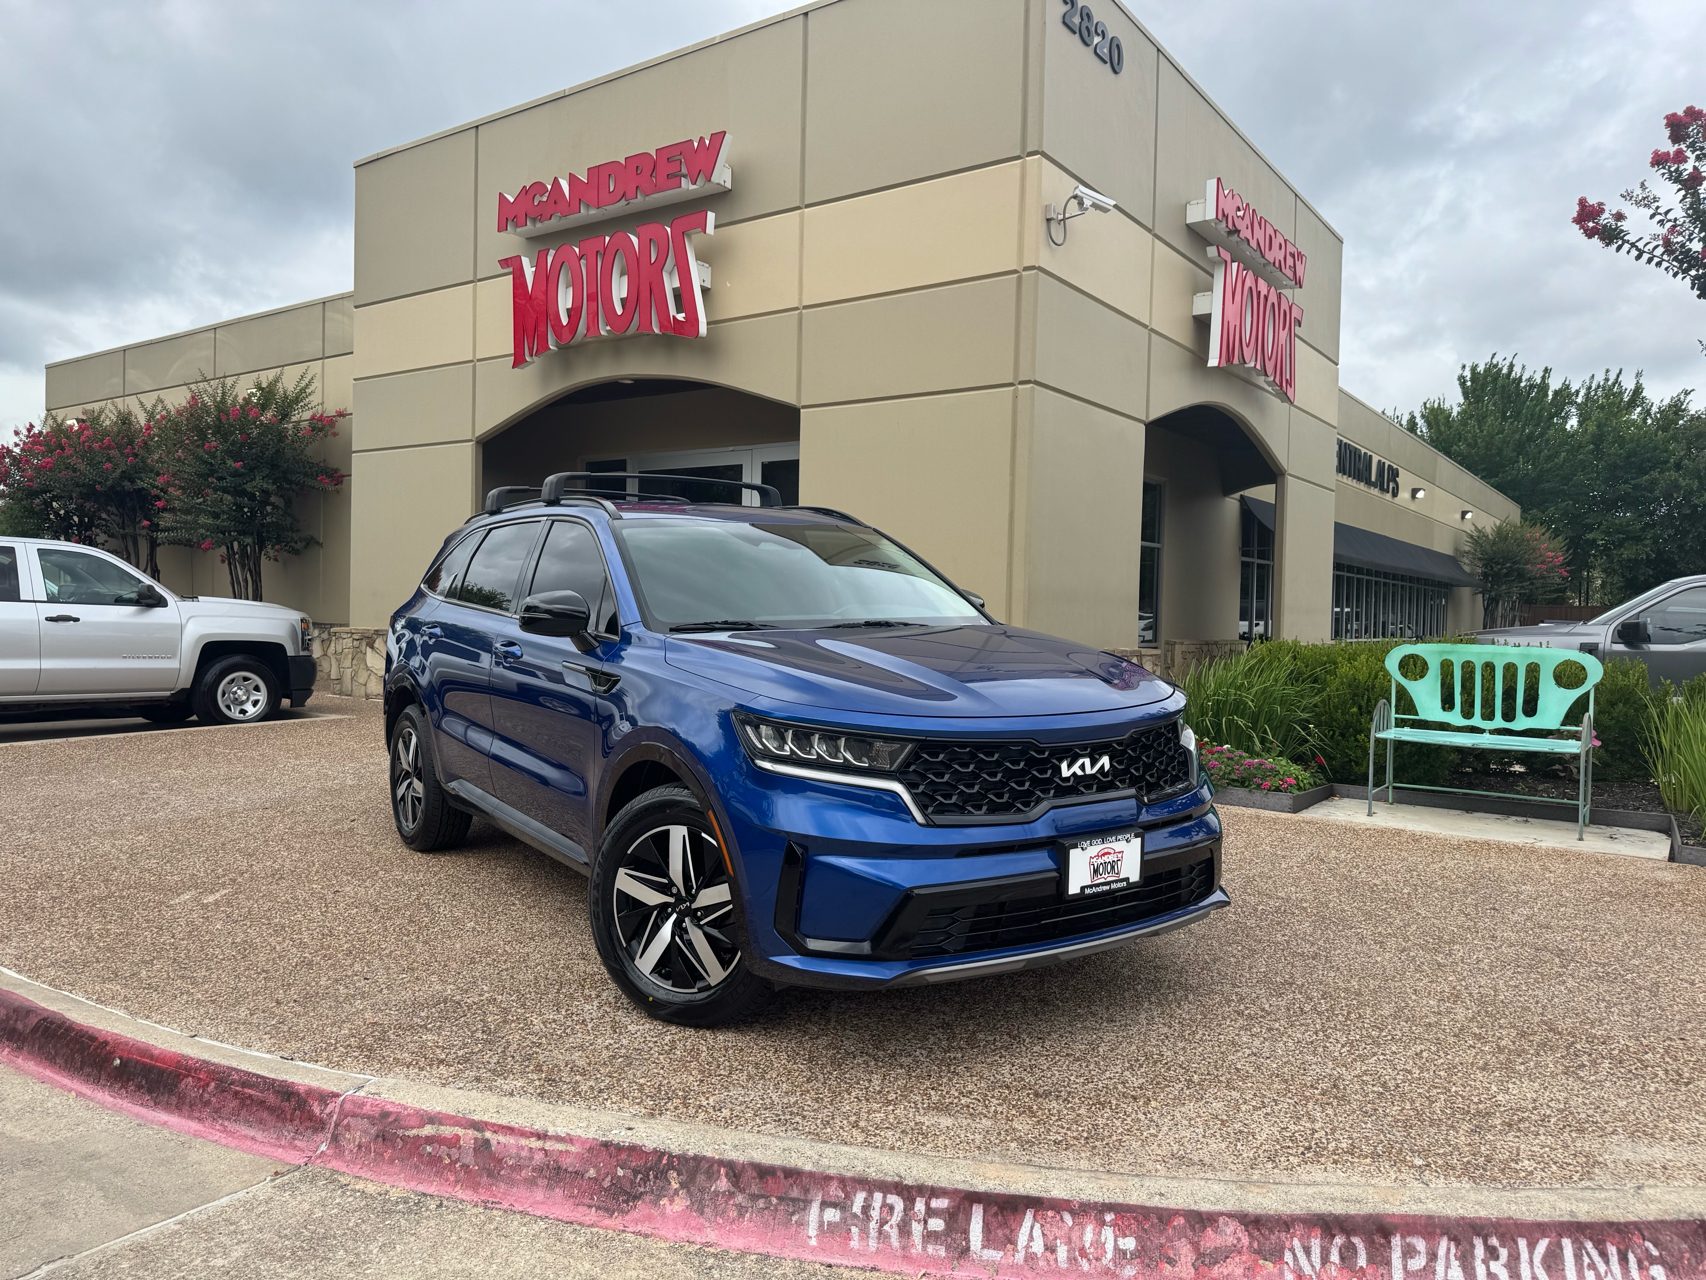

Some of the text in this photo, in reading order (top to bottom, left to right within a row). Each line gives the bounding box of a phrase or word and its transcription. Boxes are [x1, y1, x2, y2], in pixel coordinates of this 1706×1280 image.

[1062, 0, 1124, 75] 2820
[498, 210, 712, 369] MOTORS
[1216, 245, 1304, 405] MOTORS
[1060, 754, 1111, 778] KIA
[1077, 840, 1091, 849] LOVE
[1104, 836, 1117, 844] LOVE
[1084, 881, 1127, 895] McAndrew Motors
[1091, 859, 1121, 880] MOTORS
[808, 1191, 950, 1258] FIRE
[1284, 1235, 1367, 1280] NO
